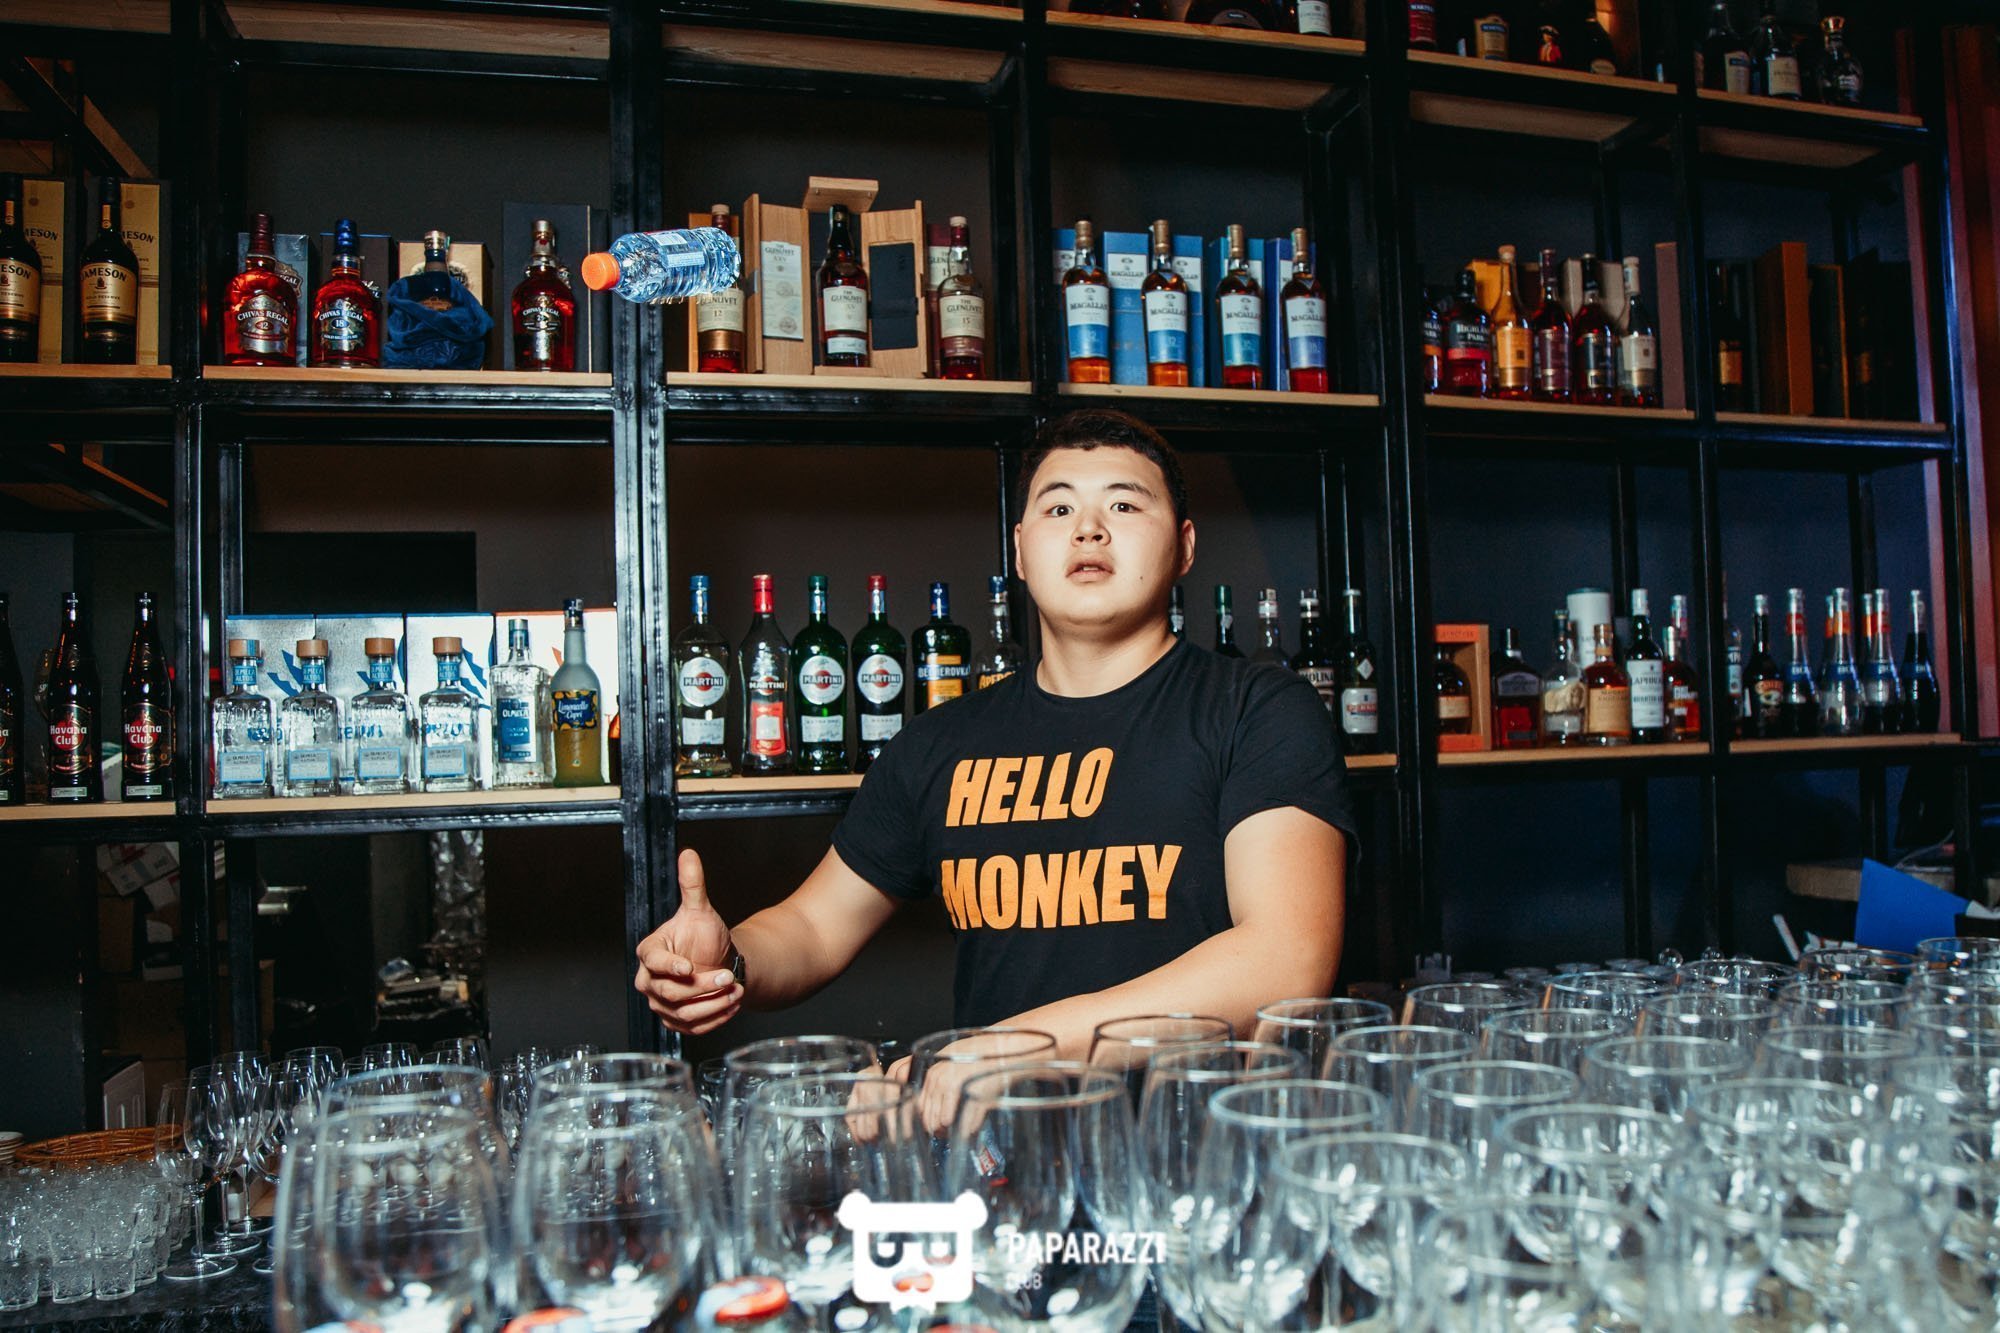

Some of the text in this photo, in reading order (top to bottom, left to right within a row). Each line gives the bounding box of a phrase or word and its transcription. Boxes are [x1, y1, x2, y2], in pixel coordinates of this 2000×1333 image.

[0, 264, 32, 279] ESON
[237, 310, 289, 326] CHIVAS REGAL
[319, 310, 341, 321] CHIVAS
[336, 319, 345, 328] 18
[918, 666, 970, 678] BEHEROVKA
[685, 677, 723, 686] MARTINI
[804, 675, 842, 684] MARTINI
[862, 674, 900, 683] MARTINI
[749, 681, 785, 689] MARTINI
[50, 724, 87, 734] Havana
[124, 723, 162, 734] Havana
[55, 735, 78, 745] Club
[130, 734, 153, 744] Club
[945, 747, 1114, 827] HELLO
[941, 844, 1183, 930] MONKEY
